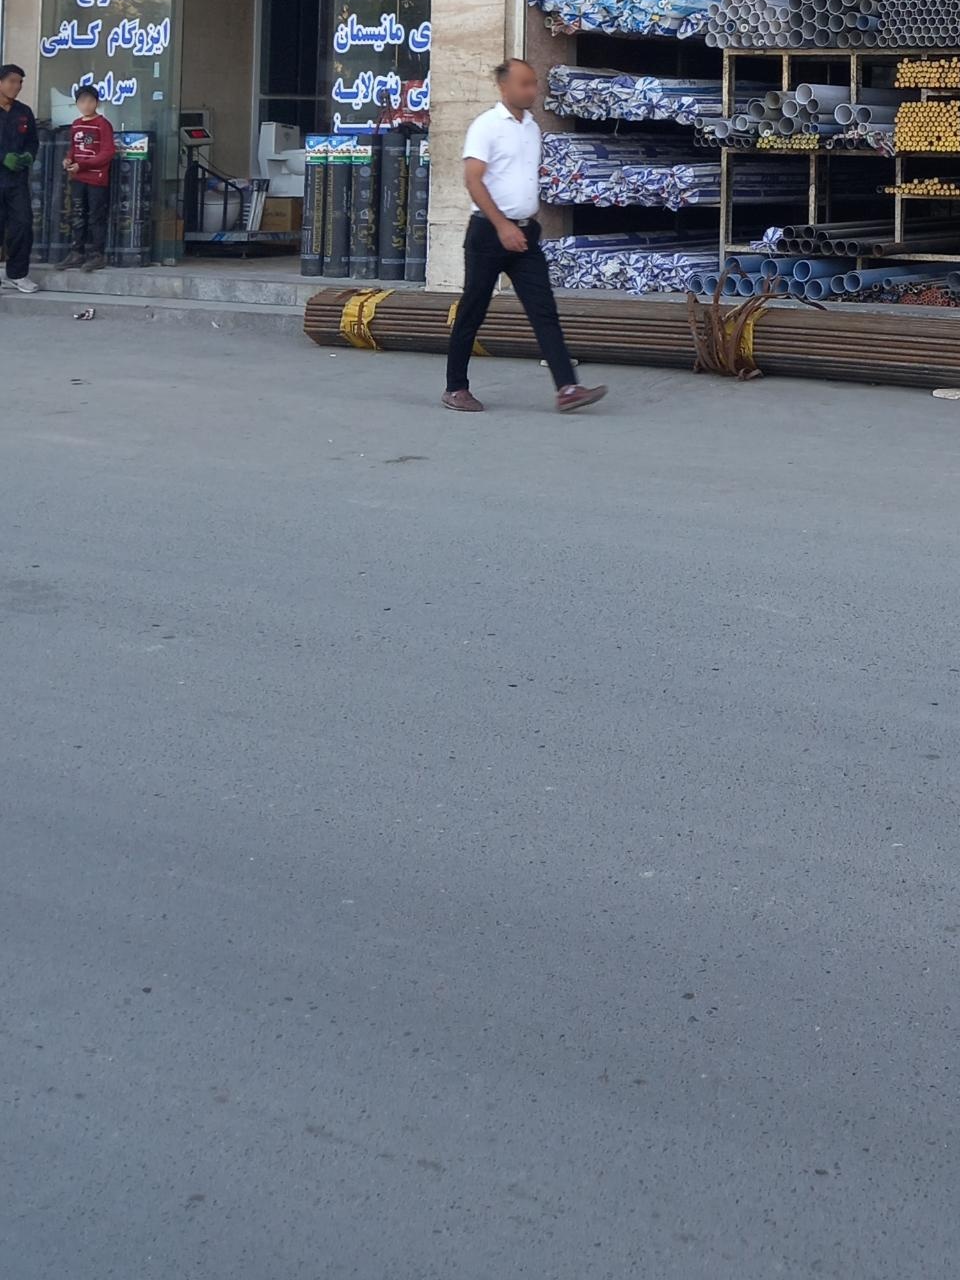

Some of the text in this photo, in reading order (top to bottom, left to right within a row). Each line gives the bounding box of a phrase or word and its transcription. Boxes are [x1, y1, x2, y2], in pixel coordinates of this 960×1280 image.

[41, 18, 170, 57] ایزوگام کاشی
[333, 14, 405, 53] مانیسمان
[72, 71, 137, 104] سرام
